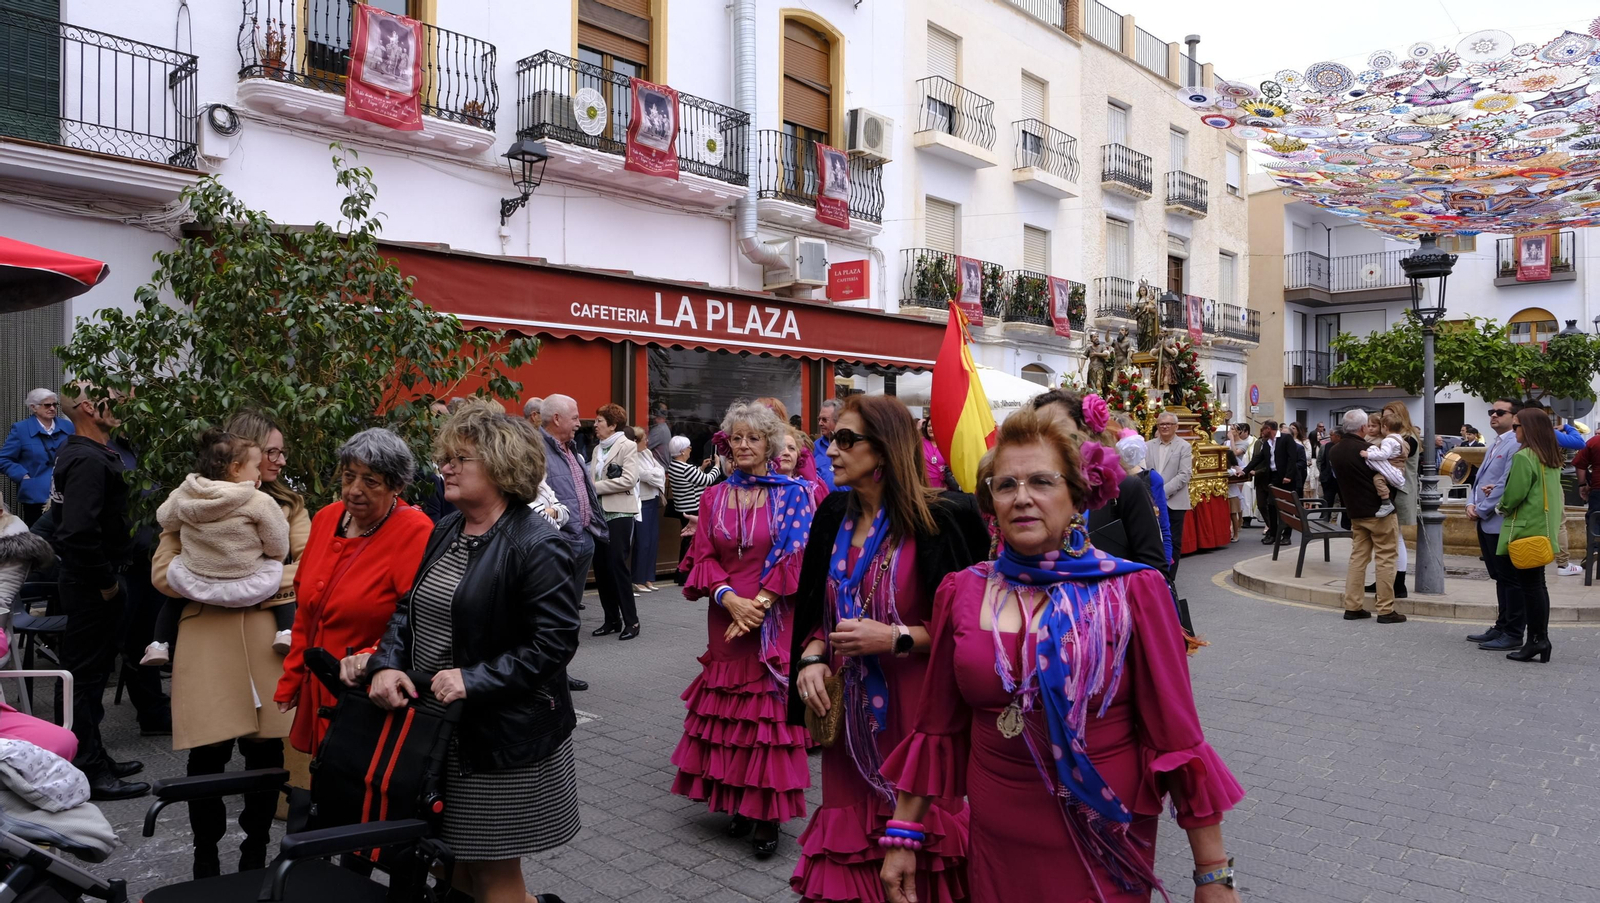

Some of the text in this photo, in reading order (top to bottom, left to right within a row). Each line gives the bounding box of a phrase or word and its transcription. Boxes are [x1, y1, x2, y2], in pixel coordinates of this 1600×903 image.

[842, 268, 861, 276] PLAZA
[570, 291, 801, 341] CAFETERIA LA PLAZA
